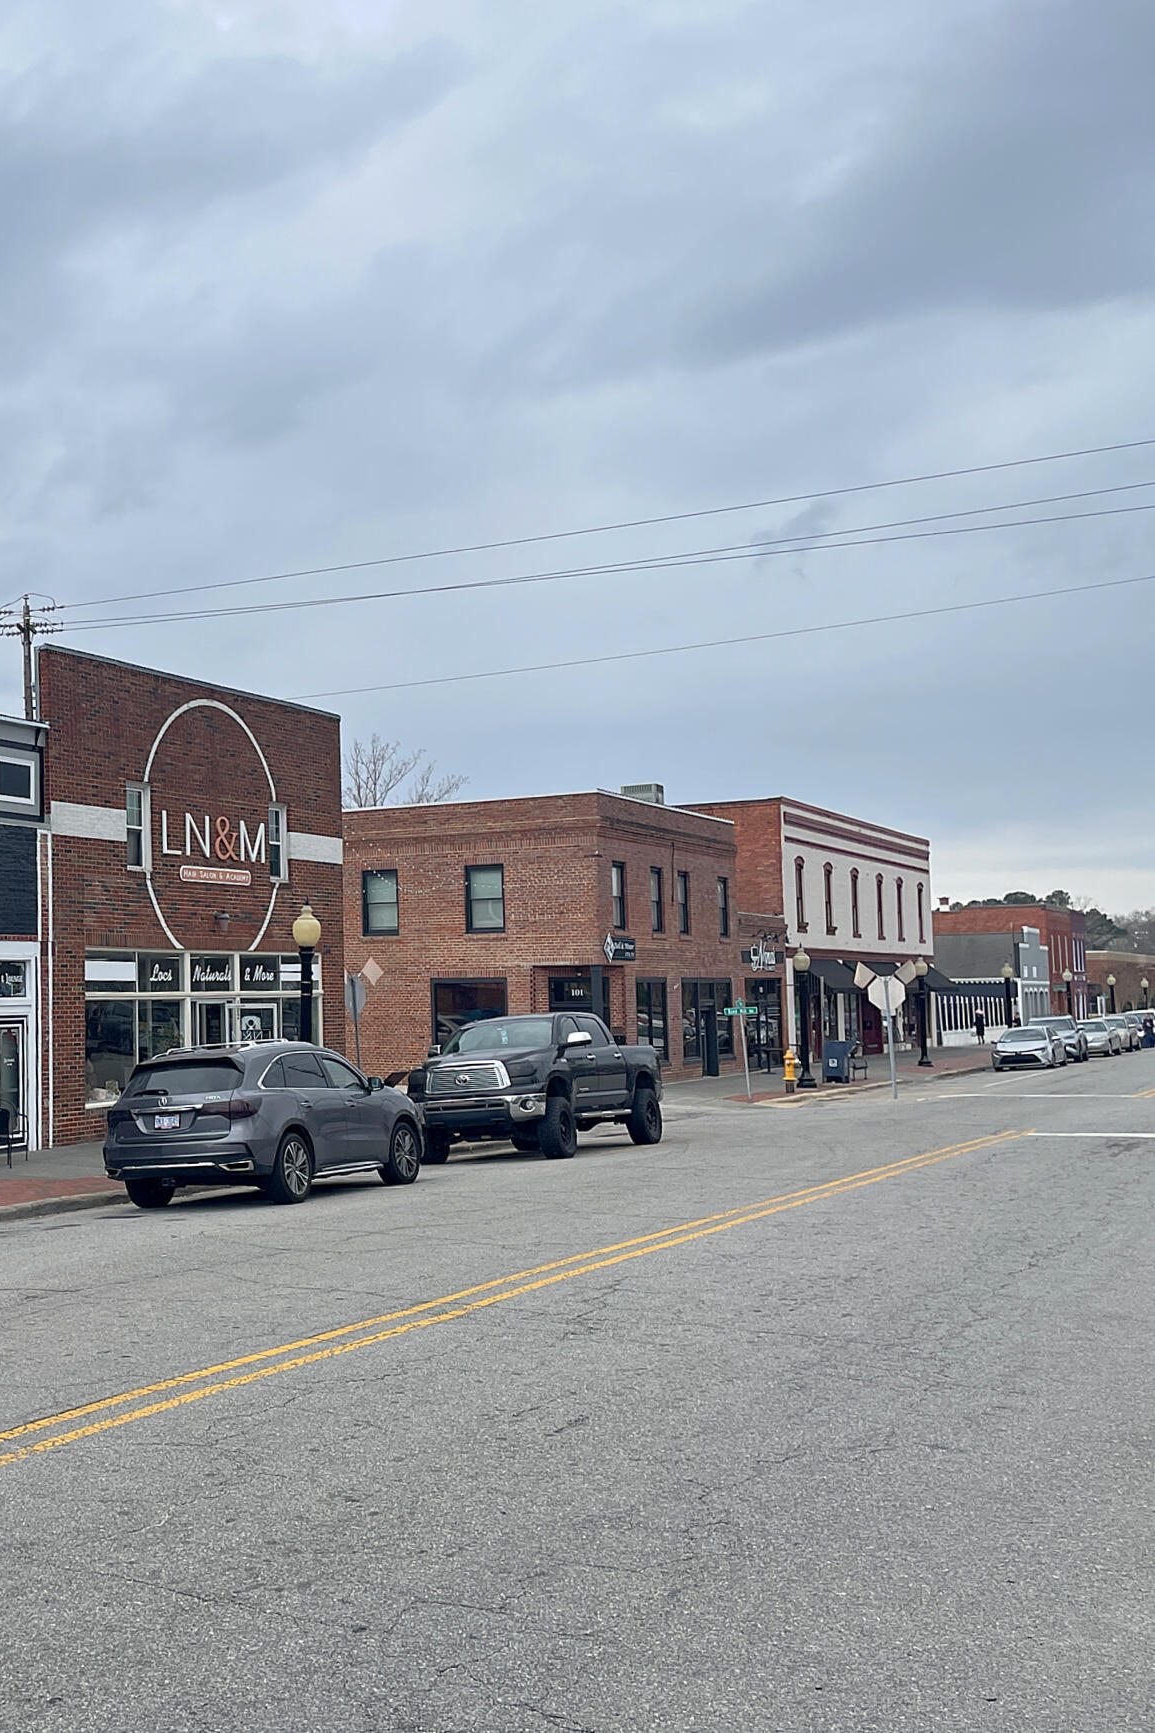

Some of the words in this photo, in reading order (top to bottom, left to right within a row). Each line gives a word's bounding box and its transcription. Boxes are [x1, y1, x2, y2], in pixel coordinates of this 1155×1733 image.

[161, 809, 266, 864] LN&M
[150, 963, 173, 982] Locs
[192, 963, 232, 982] Naturals
[244, 967, 251, 981] &
[252, 966, 275, 982] More
